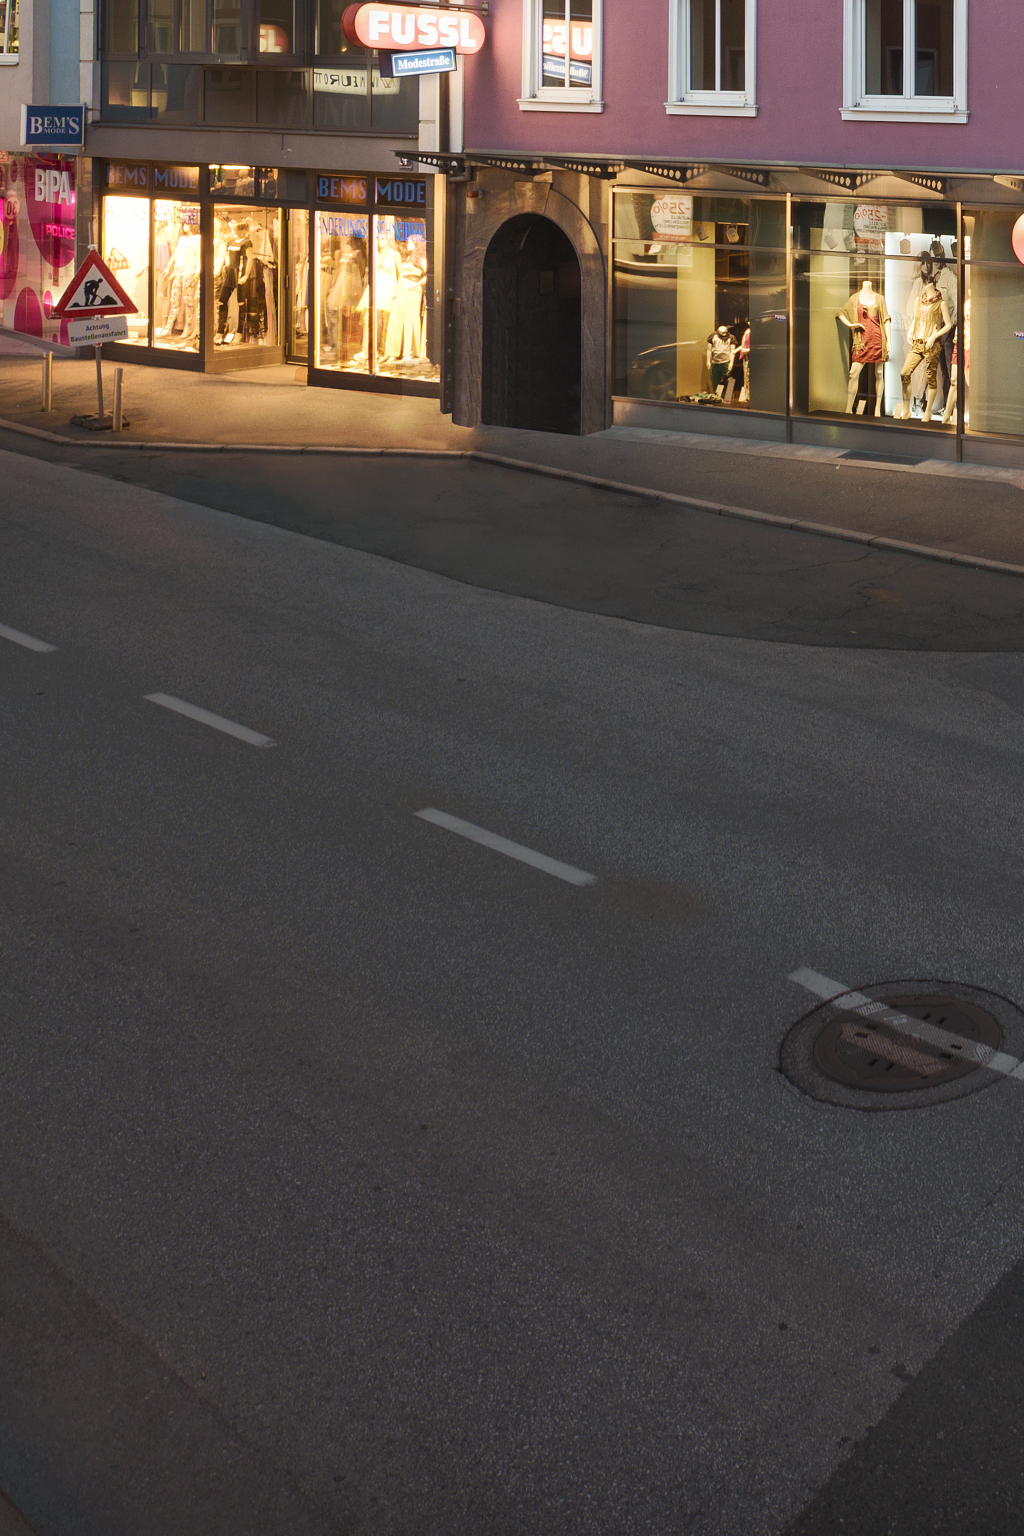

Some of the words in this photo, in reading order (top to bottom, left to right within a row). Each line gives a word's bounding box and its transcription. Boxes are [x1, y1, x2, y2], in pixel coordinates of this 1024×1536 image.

[368, 10, 477, 48] FUSSL
[397, 55, 450, 71] Modestraße
[29, 116, 80, 134] BEM'S
[34, 168, 71, 205] BIPA
[105, 165, 147, 185] BEMS
[155, 168, 197, 189] MODE
[319, 177, 367, 199] BEMS
[376, 181, 426, 203] MODE
[70, 330, 127, 342] Baustellenausfahrt
[85, 323, 110, 331] Achtung
